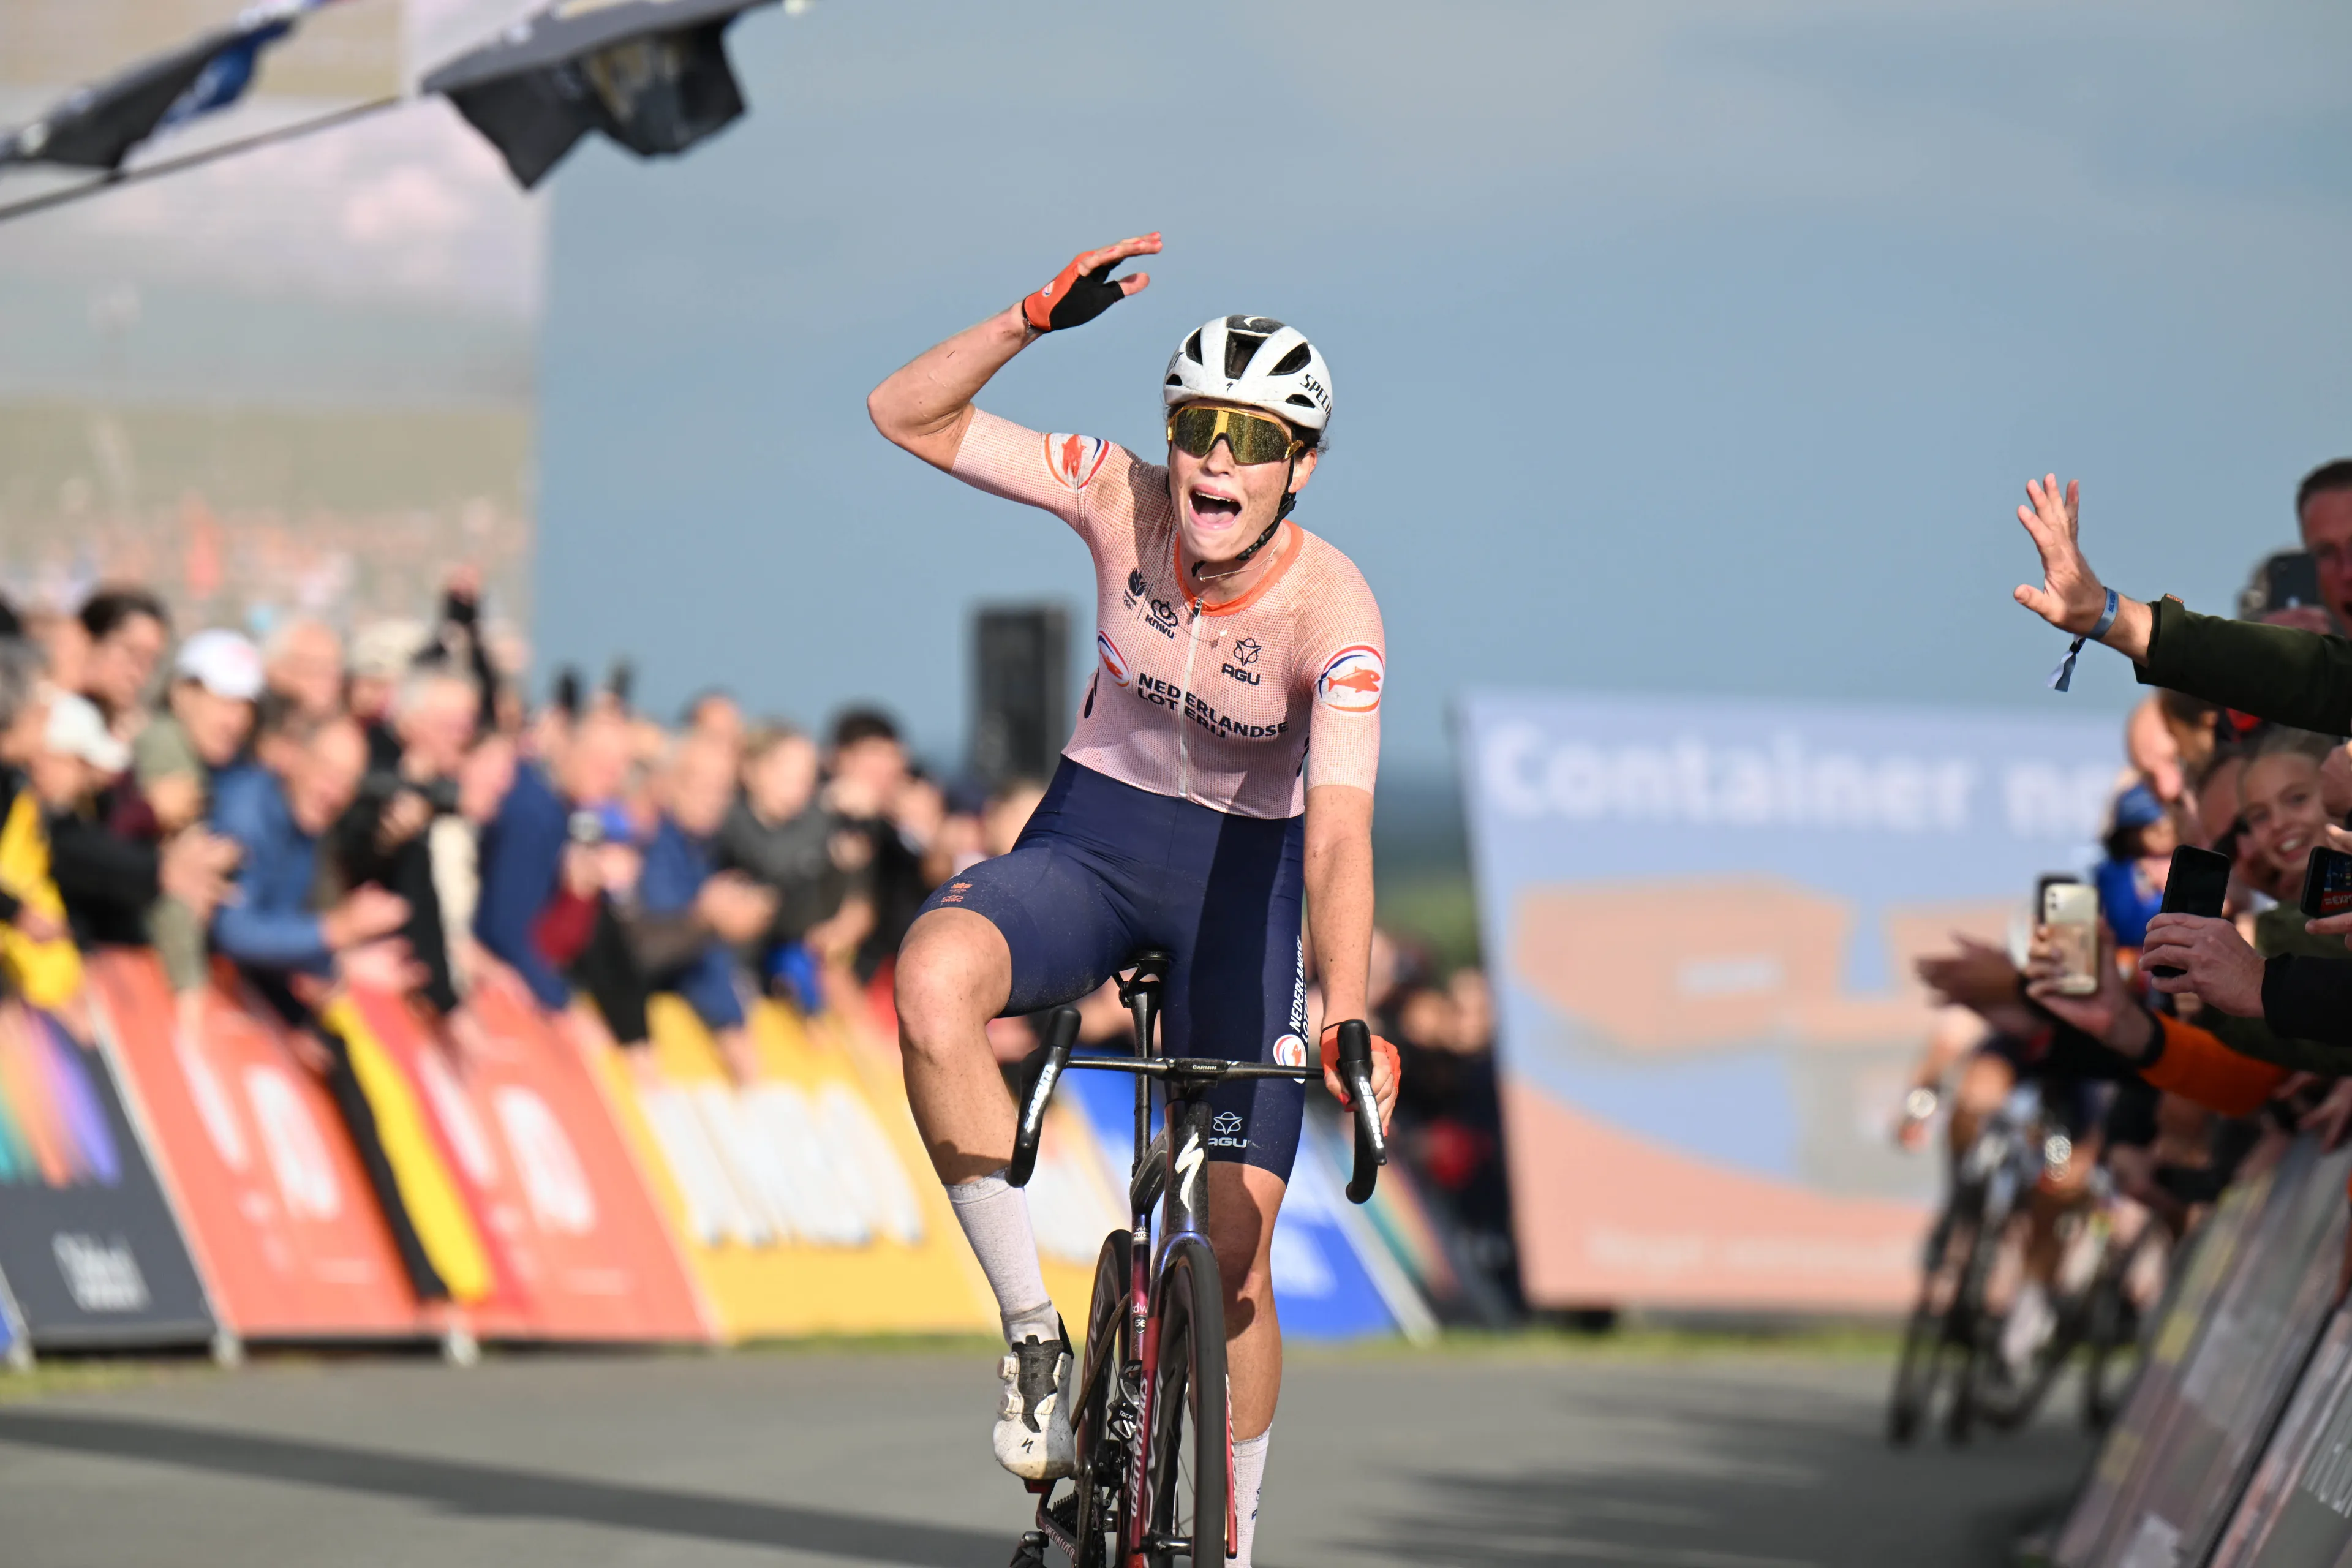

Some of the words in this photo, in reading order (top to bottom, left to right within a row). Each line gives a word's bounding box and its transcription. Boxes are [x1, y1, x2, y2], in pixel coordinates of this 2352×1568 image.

[1221, 663, 1261, 685] AGU
[1134, 1319, 1147, 1328] 56
[1119, 1410, 1134, 1420] Tacx
